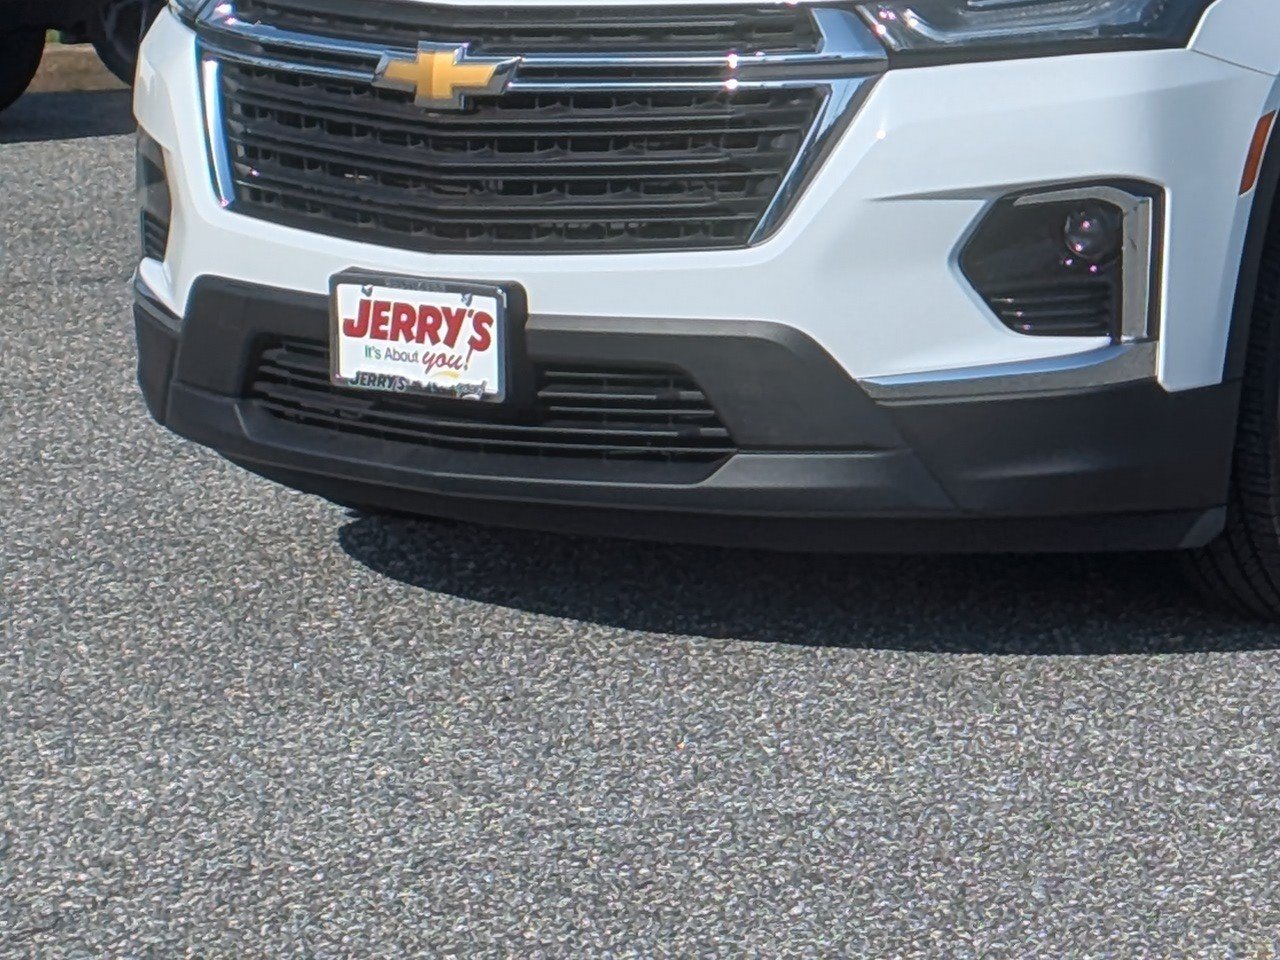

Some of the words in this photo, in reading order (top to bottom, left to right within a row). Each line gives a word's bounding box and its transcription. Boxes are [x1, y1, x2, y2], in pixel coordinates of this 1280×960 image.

[342, 298, 494, 352] JERRY'S
[364, 344, 382, 360] It's
[384, 347, 419, 364] About
[421, 346, 474, 376] you!
